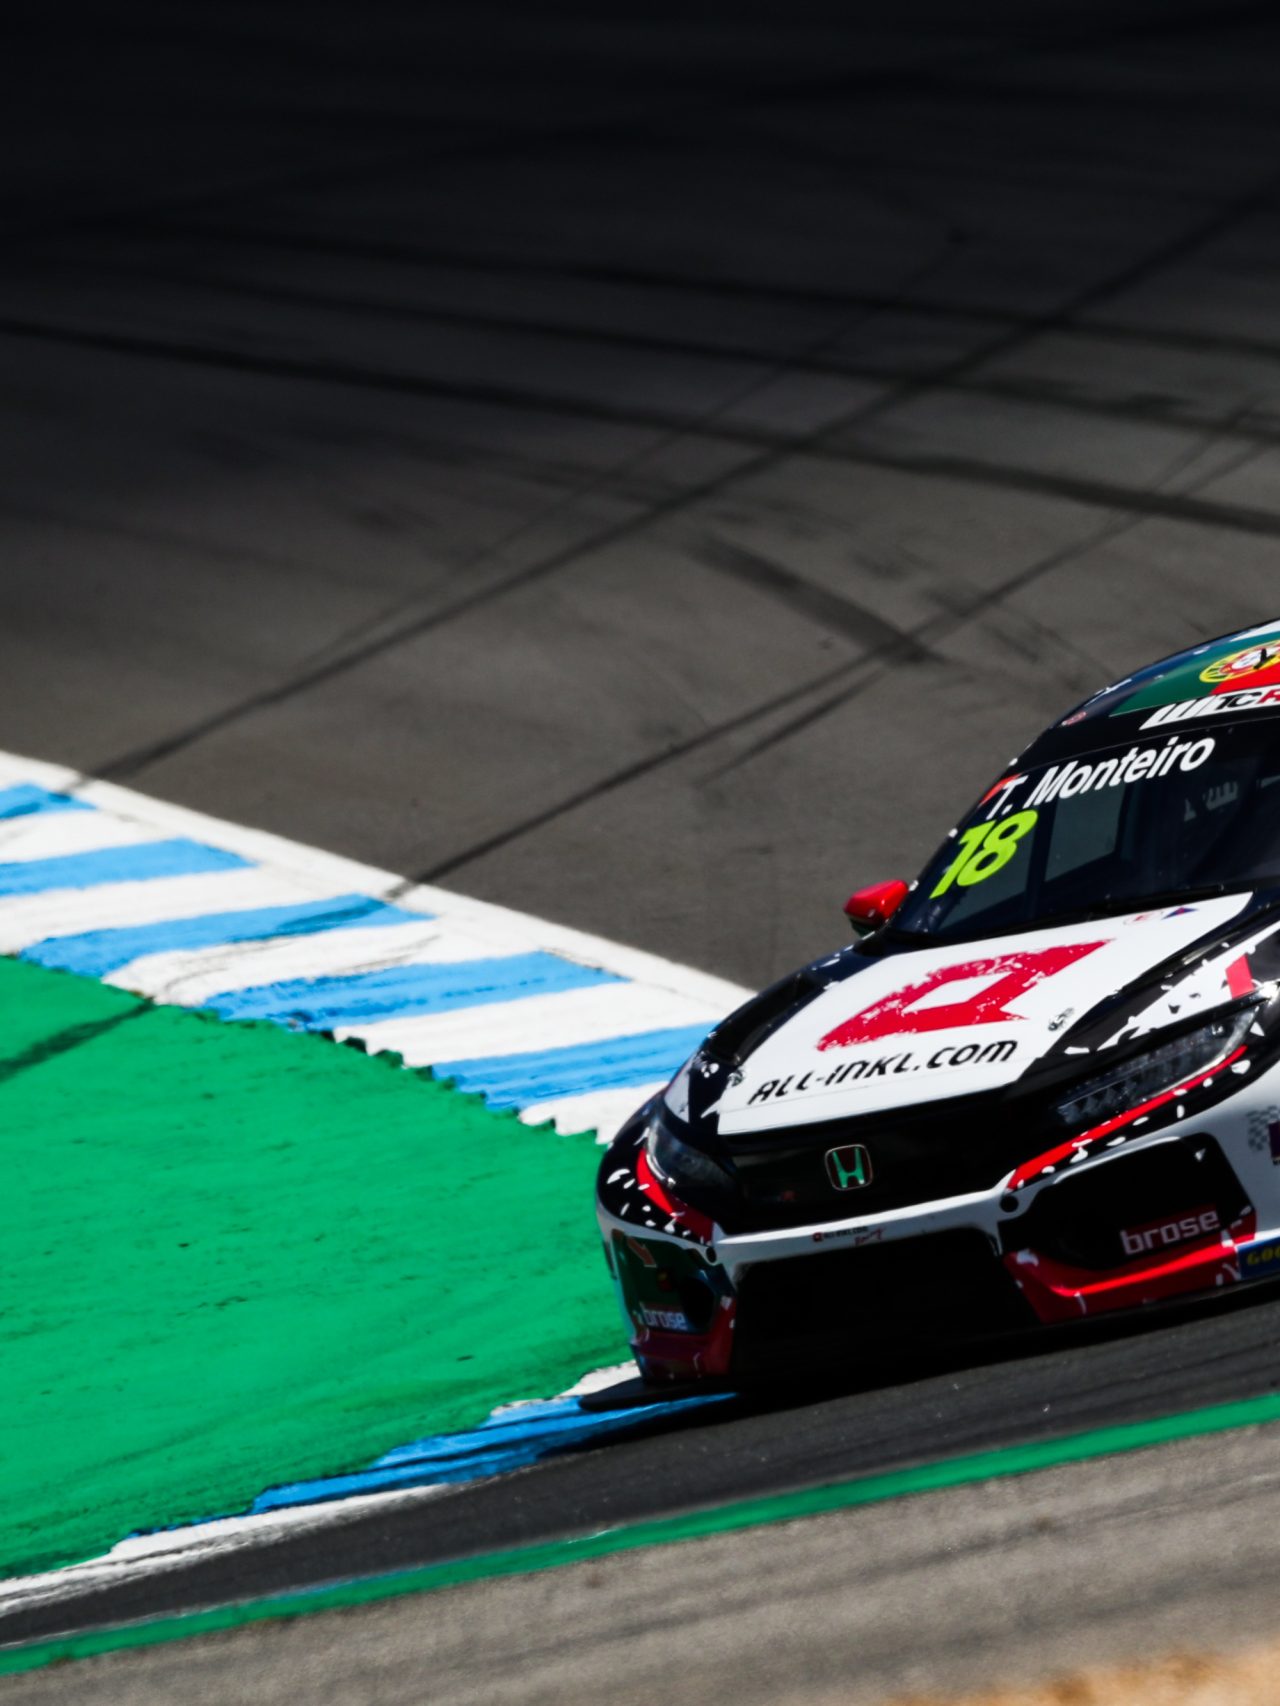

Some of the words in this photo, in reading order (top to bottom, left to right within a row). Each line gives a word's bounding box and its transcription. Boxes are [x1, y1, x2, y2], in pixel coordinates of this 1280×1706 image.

[986, 775, 1028, 821] T.
[1022, 736, 1216, 809] Monteiro
[929, 809, 1039, 899] 18
[1120, 1210, 1221, 1255] brose
